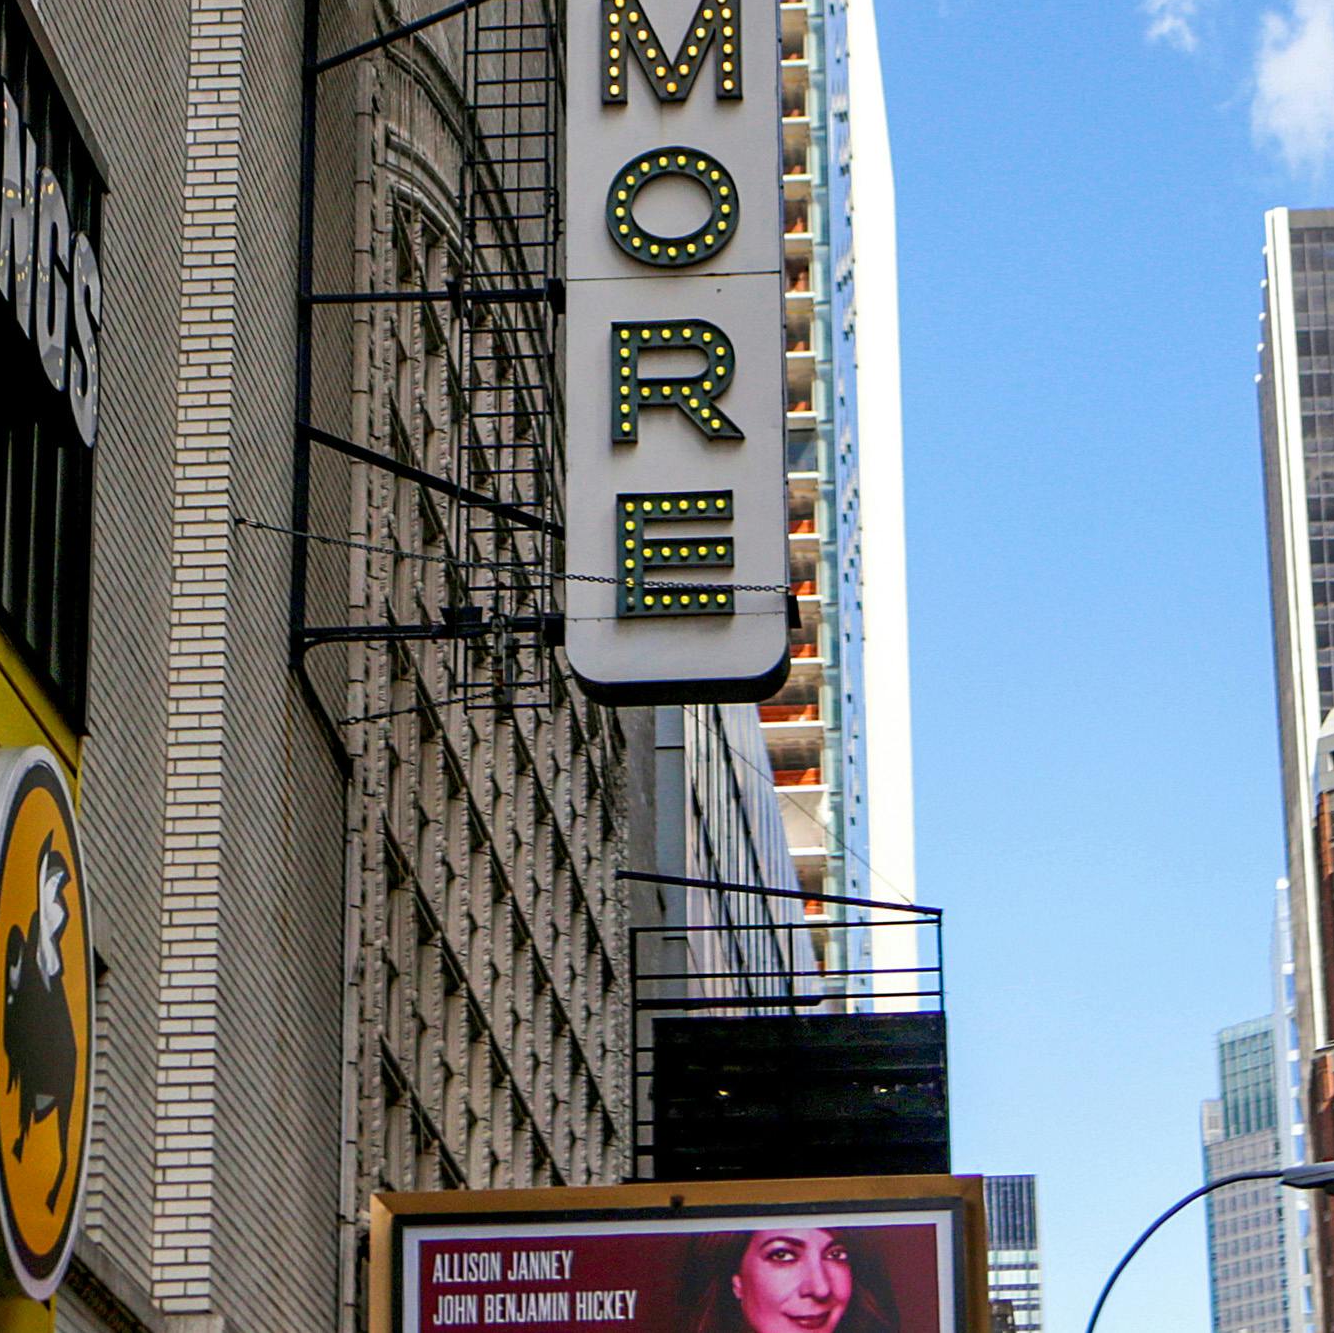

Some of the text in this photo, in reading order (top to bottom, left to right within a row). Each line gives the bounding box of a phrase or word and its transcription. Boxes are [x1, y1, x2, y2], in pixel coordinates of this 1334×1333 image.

[433, 1250, 574, 1283] ALLISON JANNEY
[433, 1290, 638, 1325] JOHN BENJAMIN HICKEY
